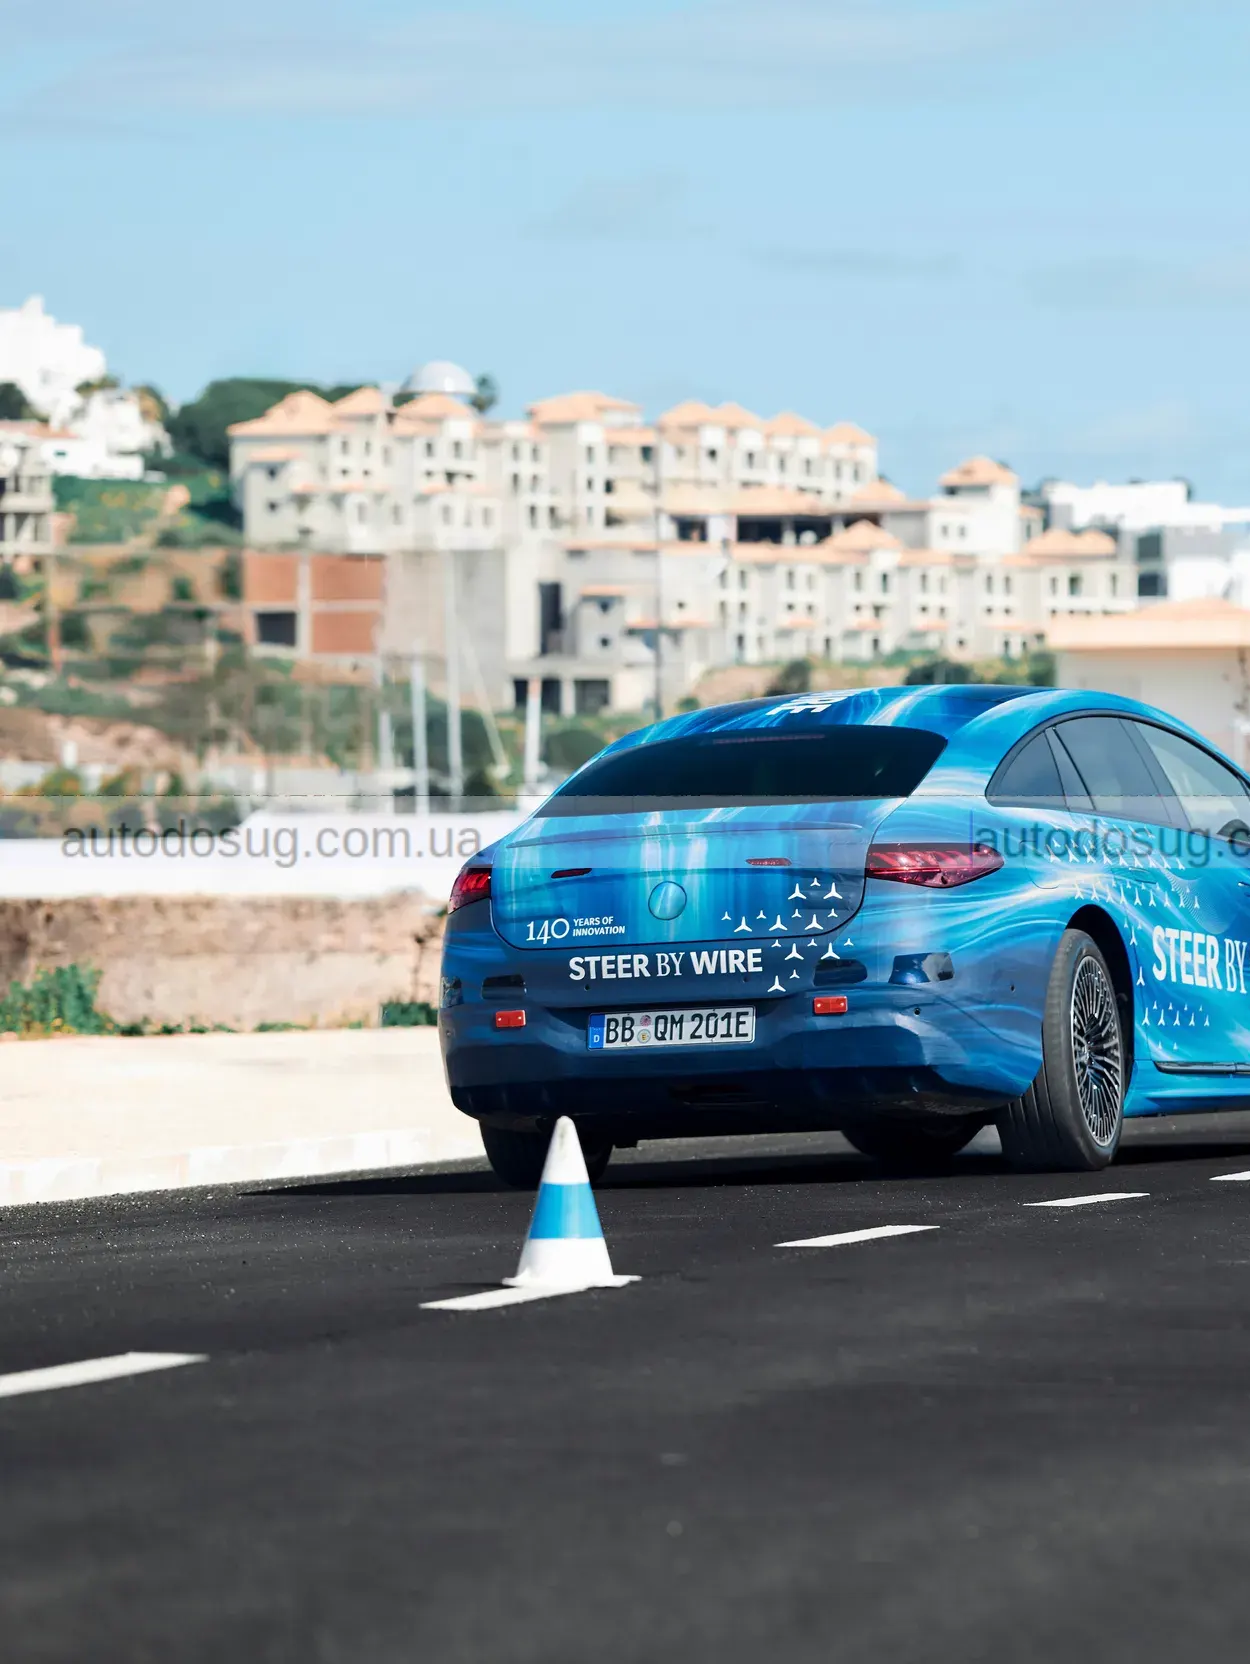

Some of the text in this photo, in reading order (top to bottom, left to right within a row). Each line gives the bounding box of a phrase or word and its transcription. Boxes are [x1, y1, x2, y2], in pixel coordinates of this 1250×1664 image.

[526, 918, 570, 945] 140
[572, 926, 626, 937] INNOVATION
[573, 916, 614, 927] YEARS OF
[569, 949, 763, 981] STEER BY WIRE
[1152, 925, 1223, 990] STEER
[1224, 938, 1247, 994] BY
[593, 1011, 750, 1044] D BB QM 201E
